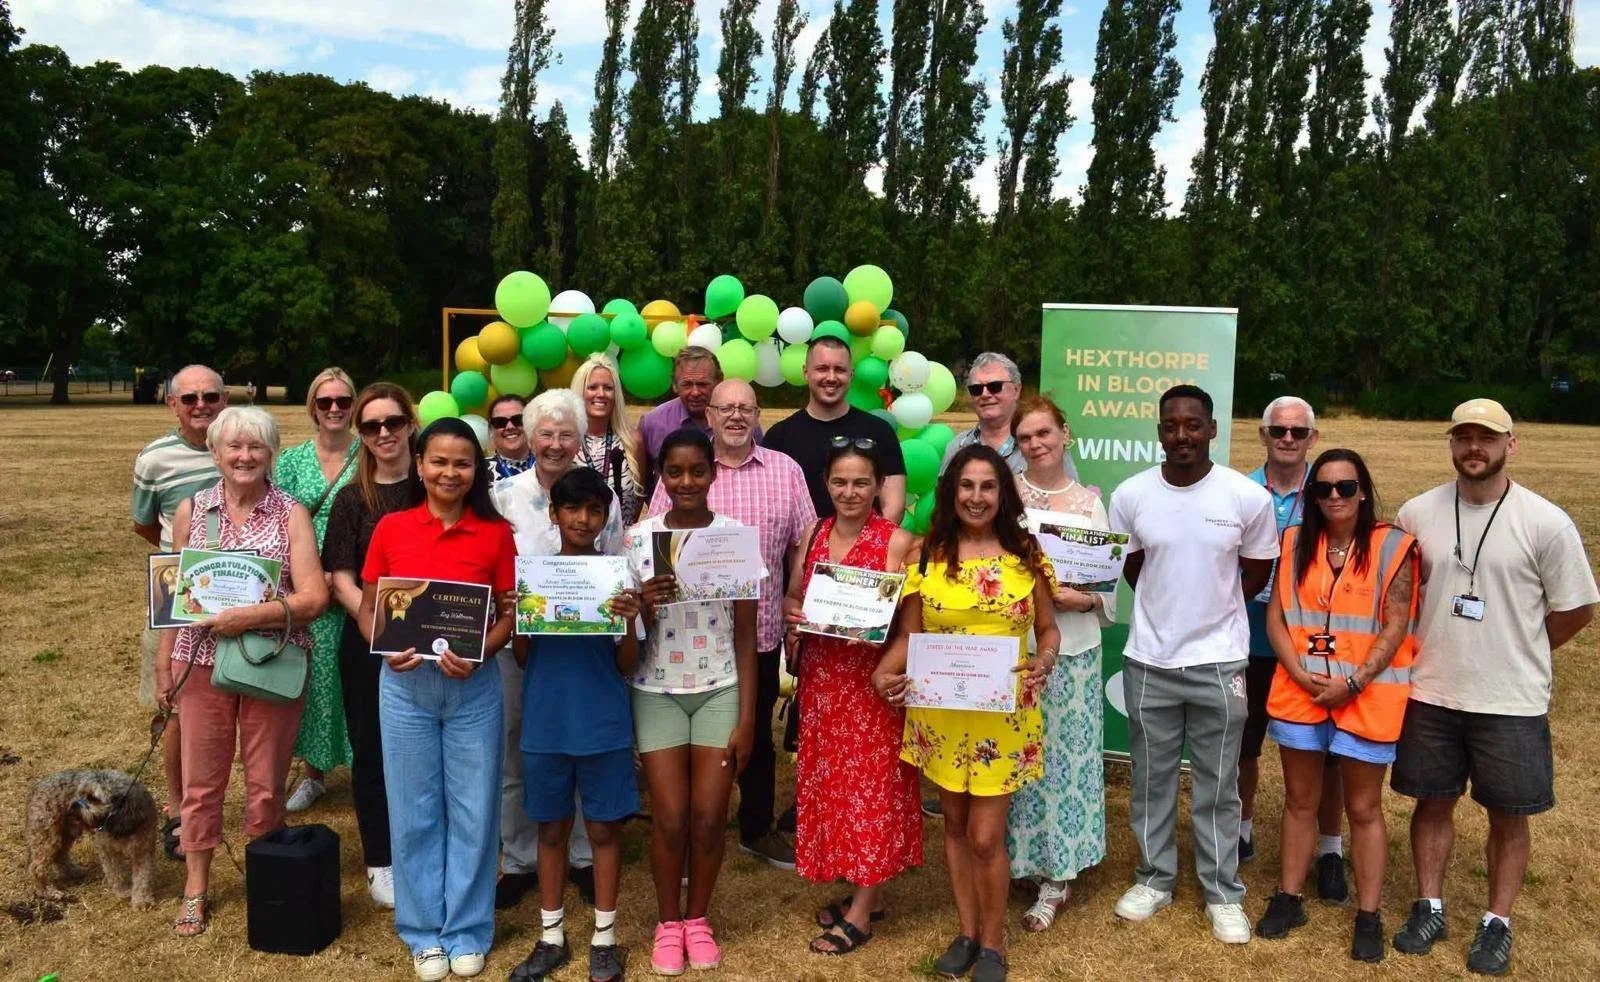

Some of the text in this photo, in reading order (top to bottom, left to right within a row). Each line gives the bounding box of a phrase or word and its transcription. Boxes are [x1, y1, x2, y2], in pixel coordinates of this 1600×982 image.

[1065, 349, 1209, 371] HEXTHORPE
[1077, 374, 1100, 392] IN
[1081, 399, 1160, 420] AWAR
[1060, 532, 1104, 544] FINALIST
[213, 570, 250, 580] FINALIST
[432, 594, 481, 605] CERTIFICATE
